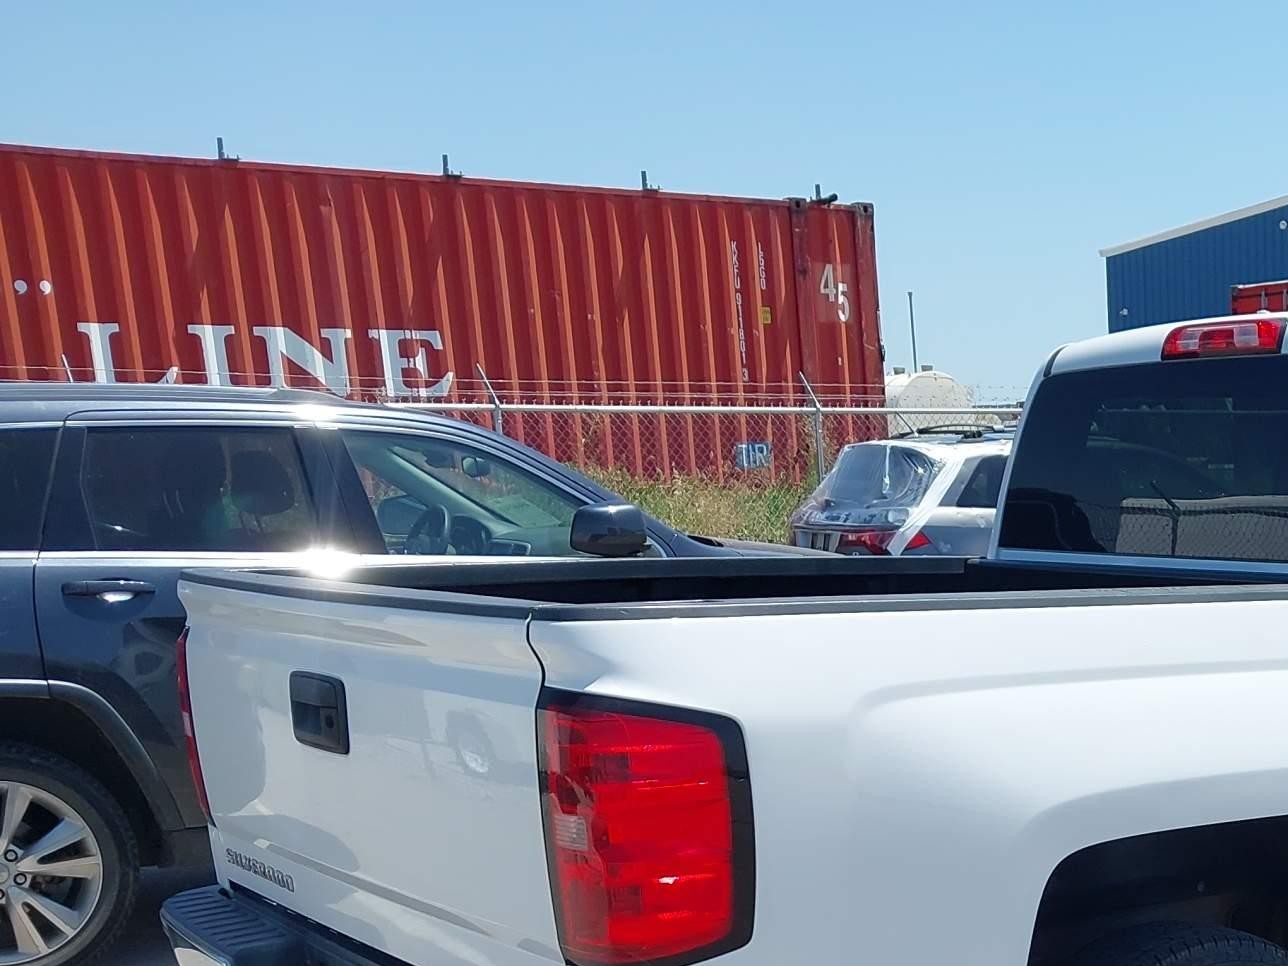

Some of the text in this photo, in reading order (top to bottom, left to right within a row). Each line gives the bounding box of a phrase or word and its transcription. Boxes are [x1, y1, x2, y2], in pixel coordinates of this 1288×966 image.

[77, 322, 454, 399] LINE
[738, 443, 768, 467] TIR
[225, 847, 295, 893] SILVERADO
